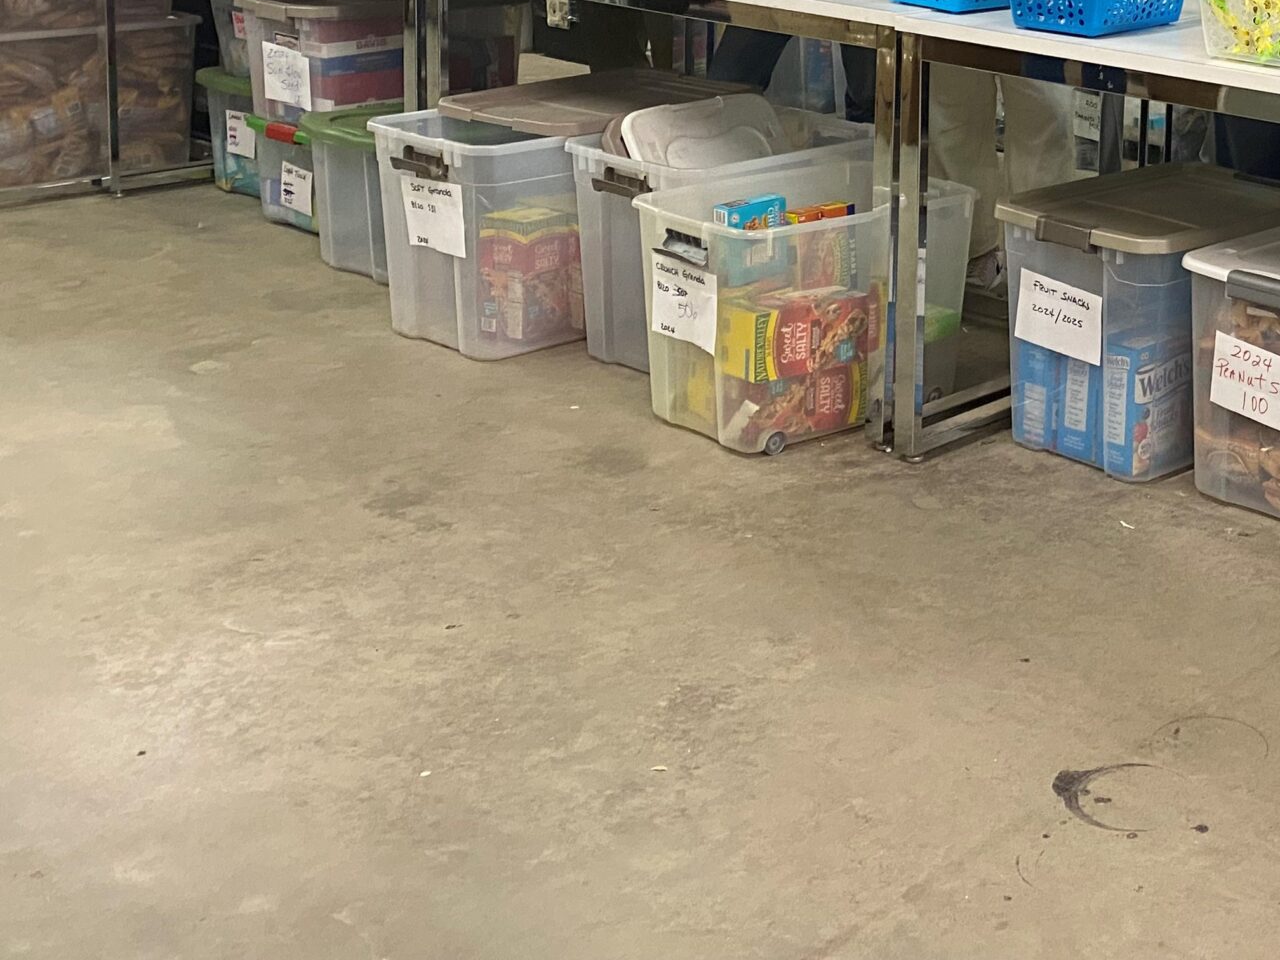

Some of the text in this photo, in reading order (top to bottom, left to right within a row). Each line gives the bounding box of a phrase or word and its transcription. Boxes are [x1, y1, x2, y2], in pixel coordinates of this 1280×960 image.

[1033, 280, 1057, 296] FRUIT
[1032, 303, 1084, 328] 2024/2025
[794, 321, 807, 360] SALTY
[1231, 345, 1273, 373] 2024
[1139, 358, 1190, 398] Welch's
[1242, 391, 1268, 415] 100
